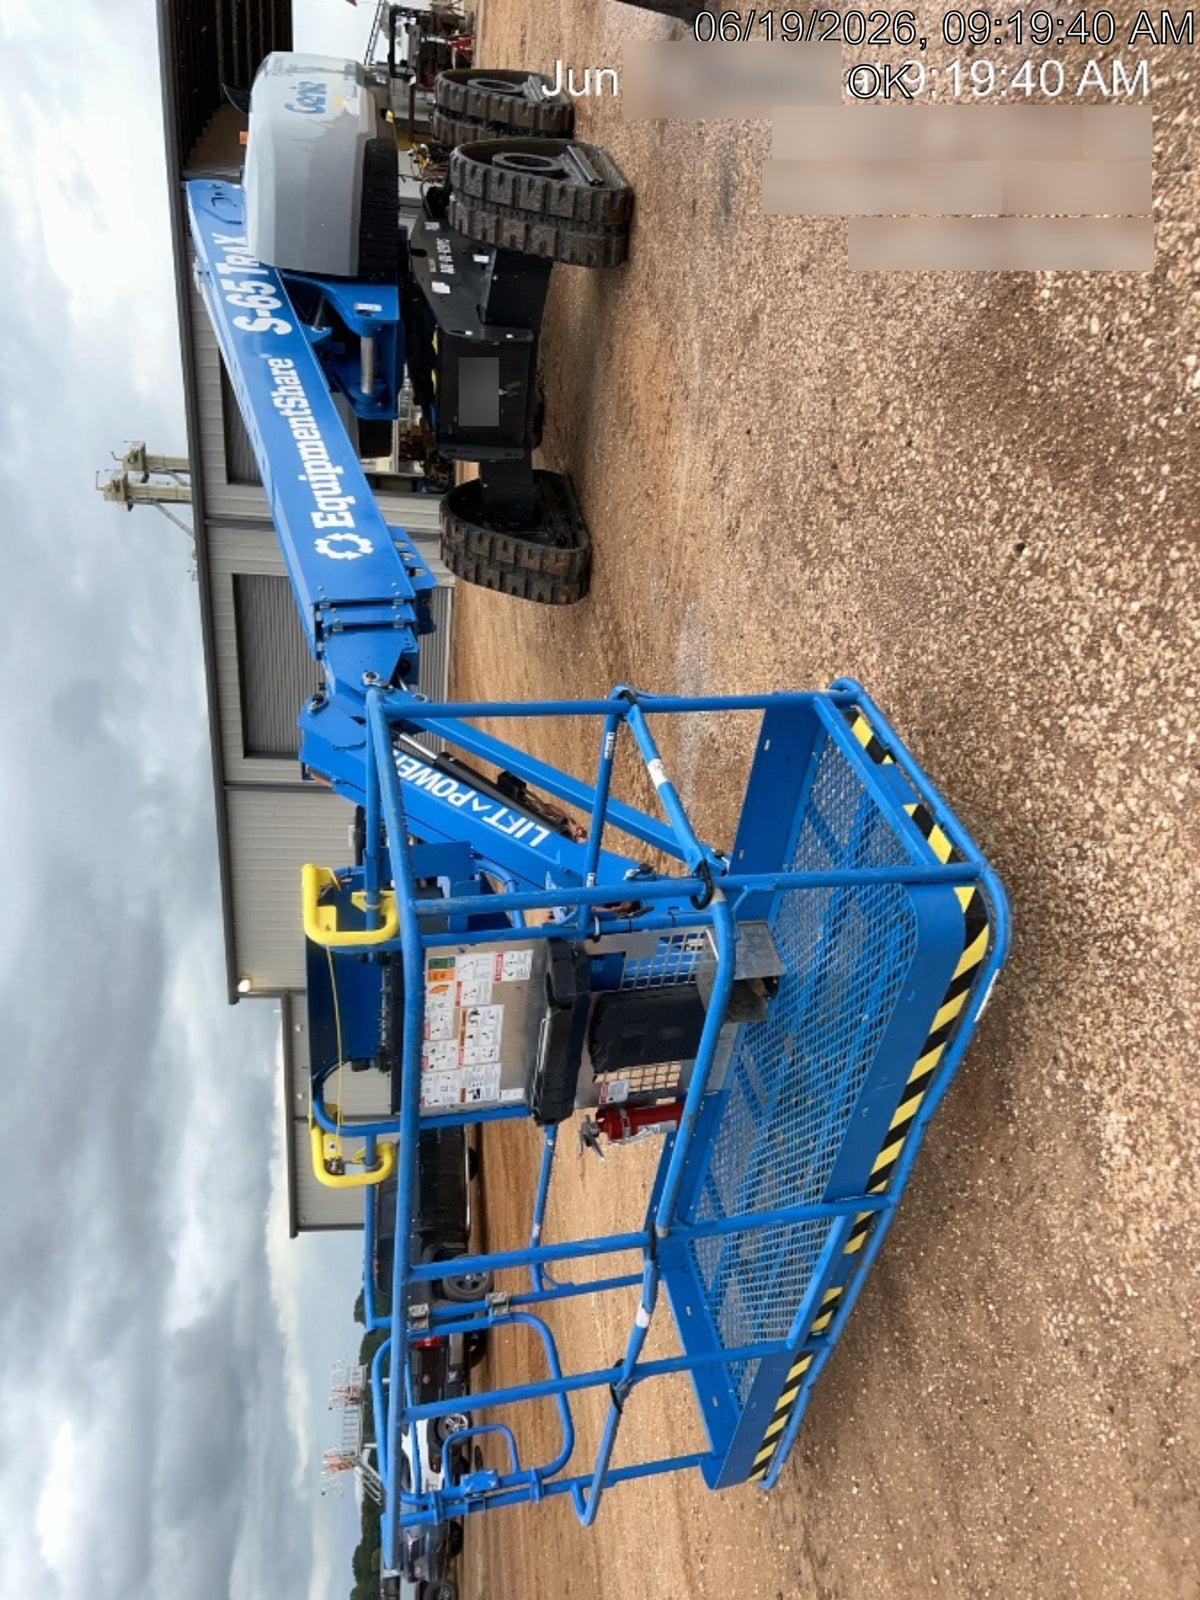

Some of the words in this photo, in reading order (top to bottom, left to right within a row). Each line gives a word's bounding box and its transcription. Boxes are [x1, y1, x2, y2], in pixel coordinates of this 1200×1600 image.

[221, 279, 293, 335] S-65
[267, 358, 356, 529] EquipmentShare
[481, 806, 551, 847] LIFT
